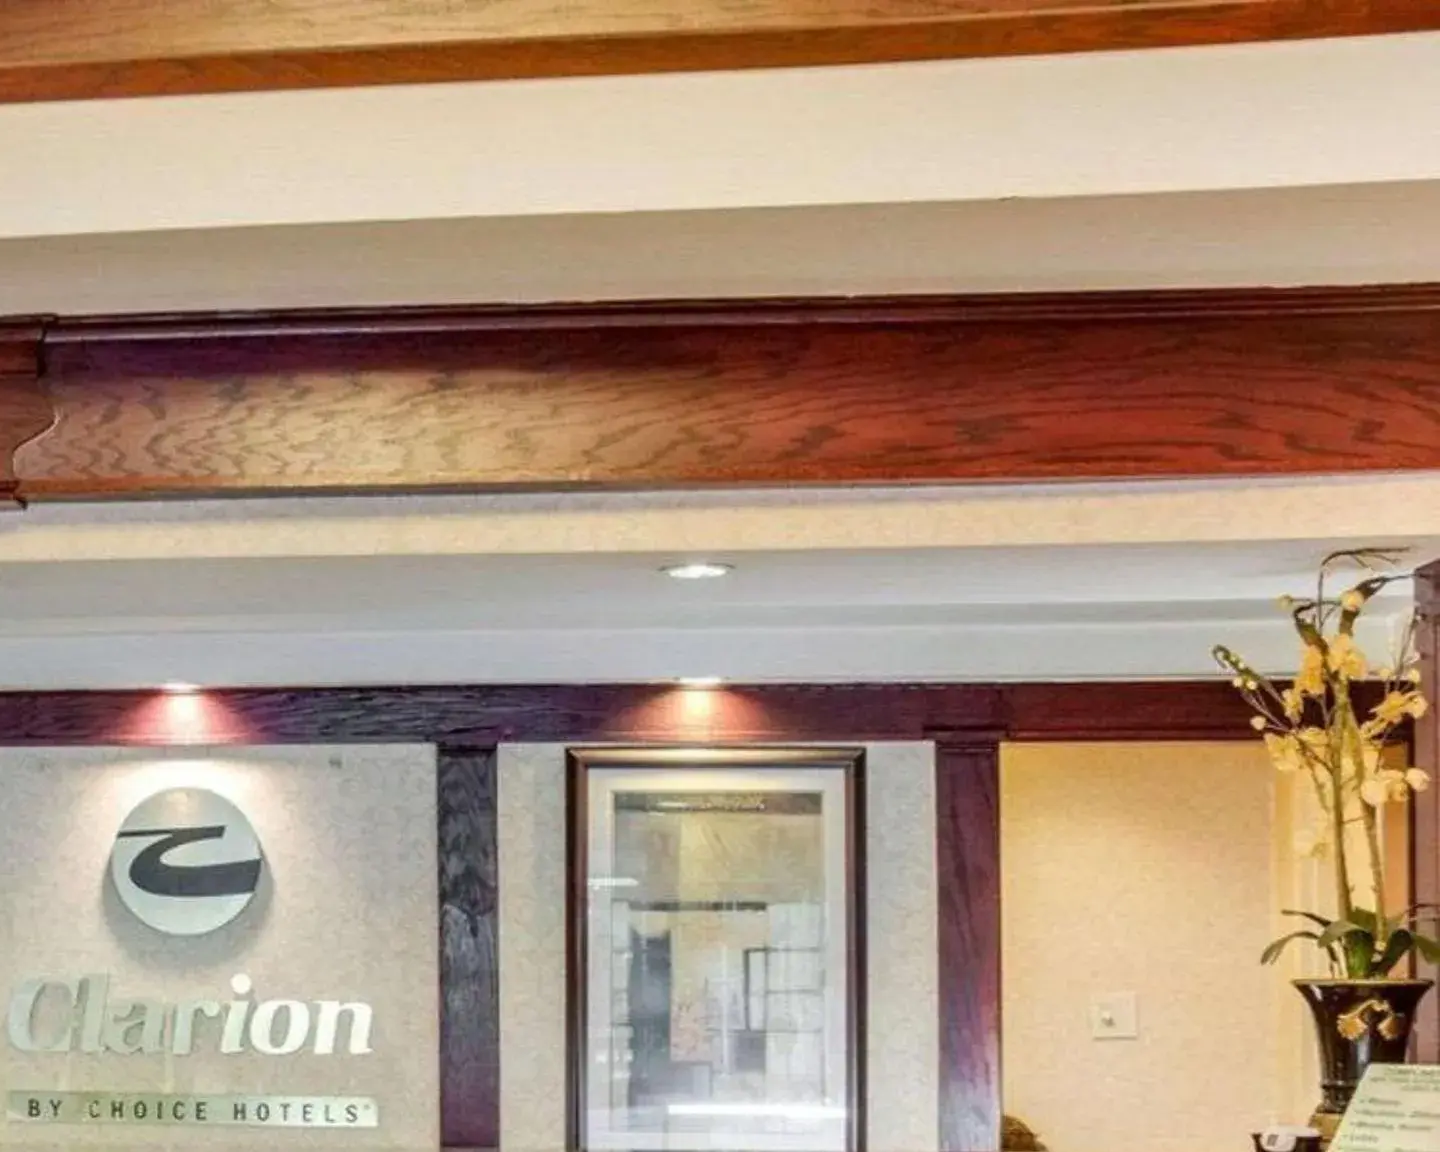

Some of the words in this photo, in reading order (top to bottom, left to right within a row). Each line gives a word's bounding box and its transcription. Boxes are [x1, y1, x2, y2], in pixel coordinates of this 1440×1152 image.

[8, 973, 374, 1055] Clarion
[27, 1097, 62, 1119] BY
[88, 1099, 208, 1121] CHOICE
[232, 1102, 359, 1123] HOTELS
